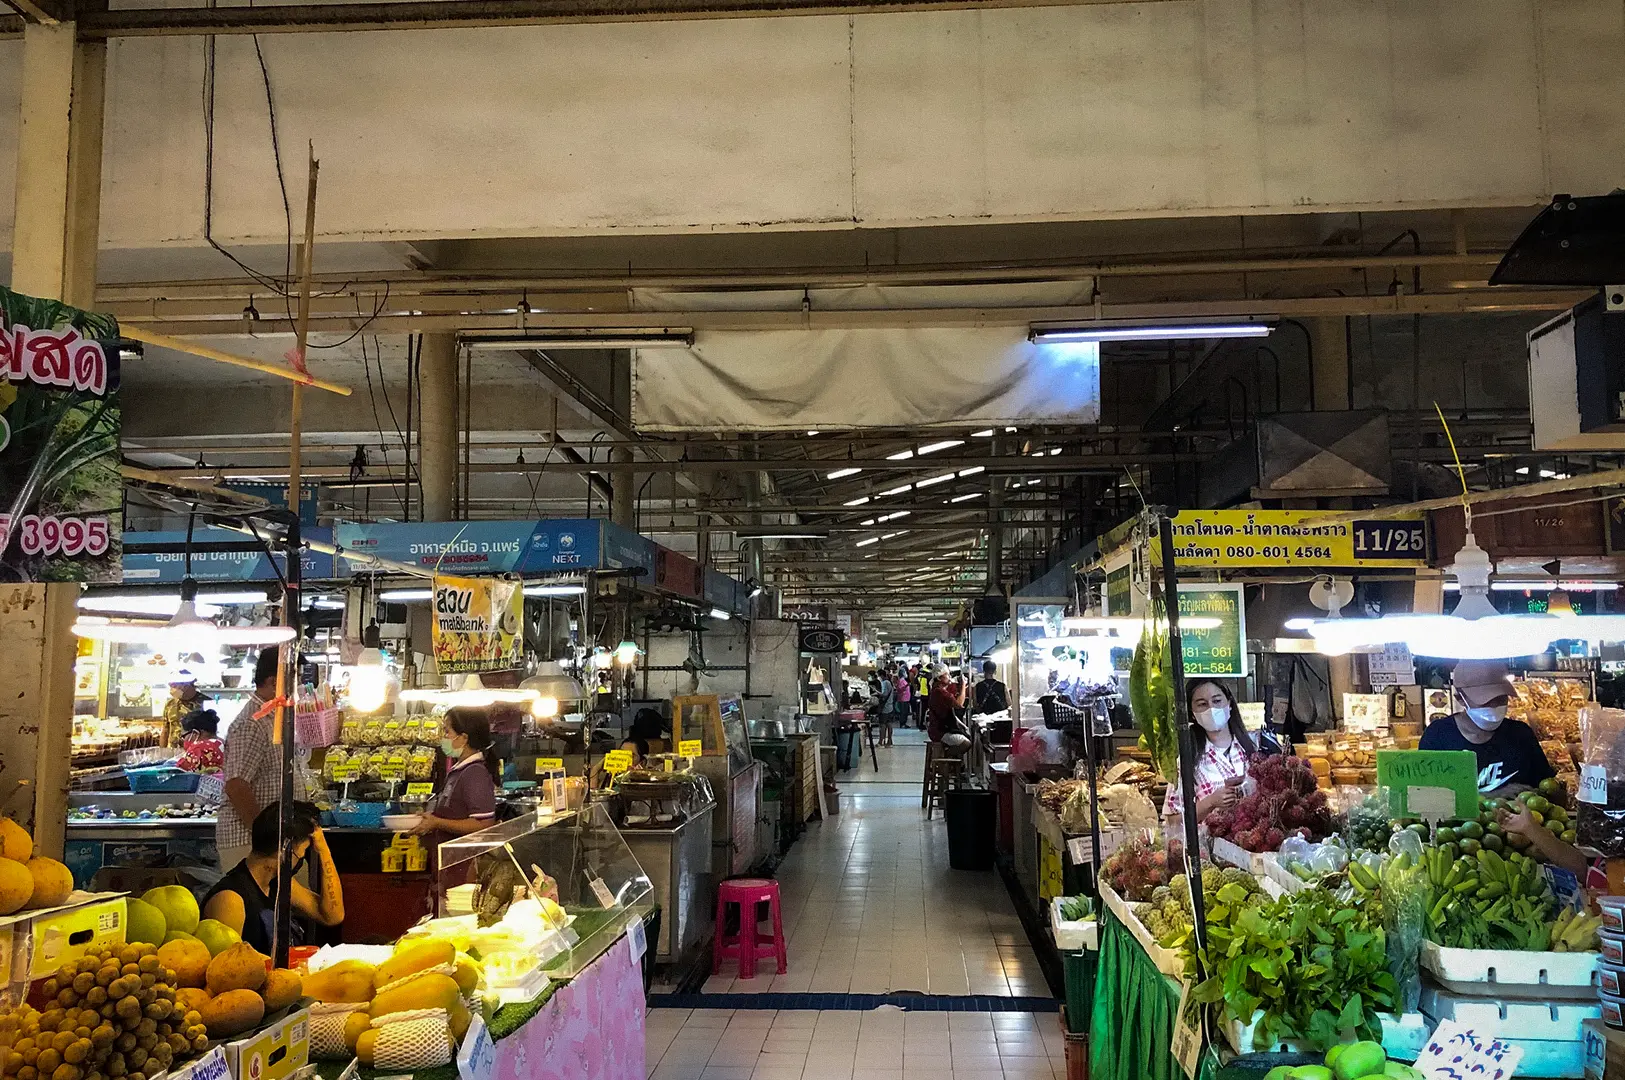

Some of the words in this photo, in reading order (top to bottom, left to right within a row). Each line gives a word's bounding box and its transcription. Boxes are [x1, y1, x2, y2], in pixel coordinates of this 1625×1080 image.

[1172, 514, 1347, 536] าลโตนด-น้ำตาลมะพราว
[1534, 518, 1564, 527] 11/26
[23, 518, 107, 552] 3995
[1354, 528, 1424, 551] 11/25
[410, 539, 477, 555] อาหารเหนือ
[481, 538, 520, 553] จ.แพร่
[1226, 546, 1290, 558] 080-601
[1294, 546, 1332, 558] 4564
[552, 554, 581, 564] NEXT
[437, 588, 472, 614] สวน
[1183, 662, 1233, 673] 321-584
